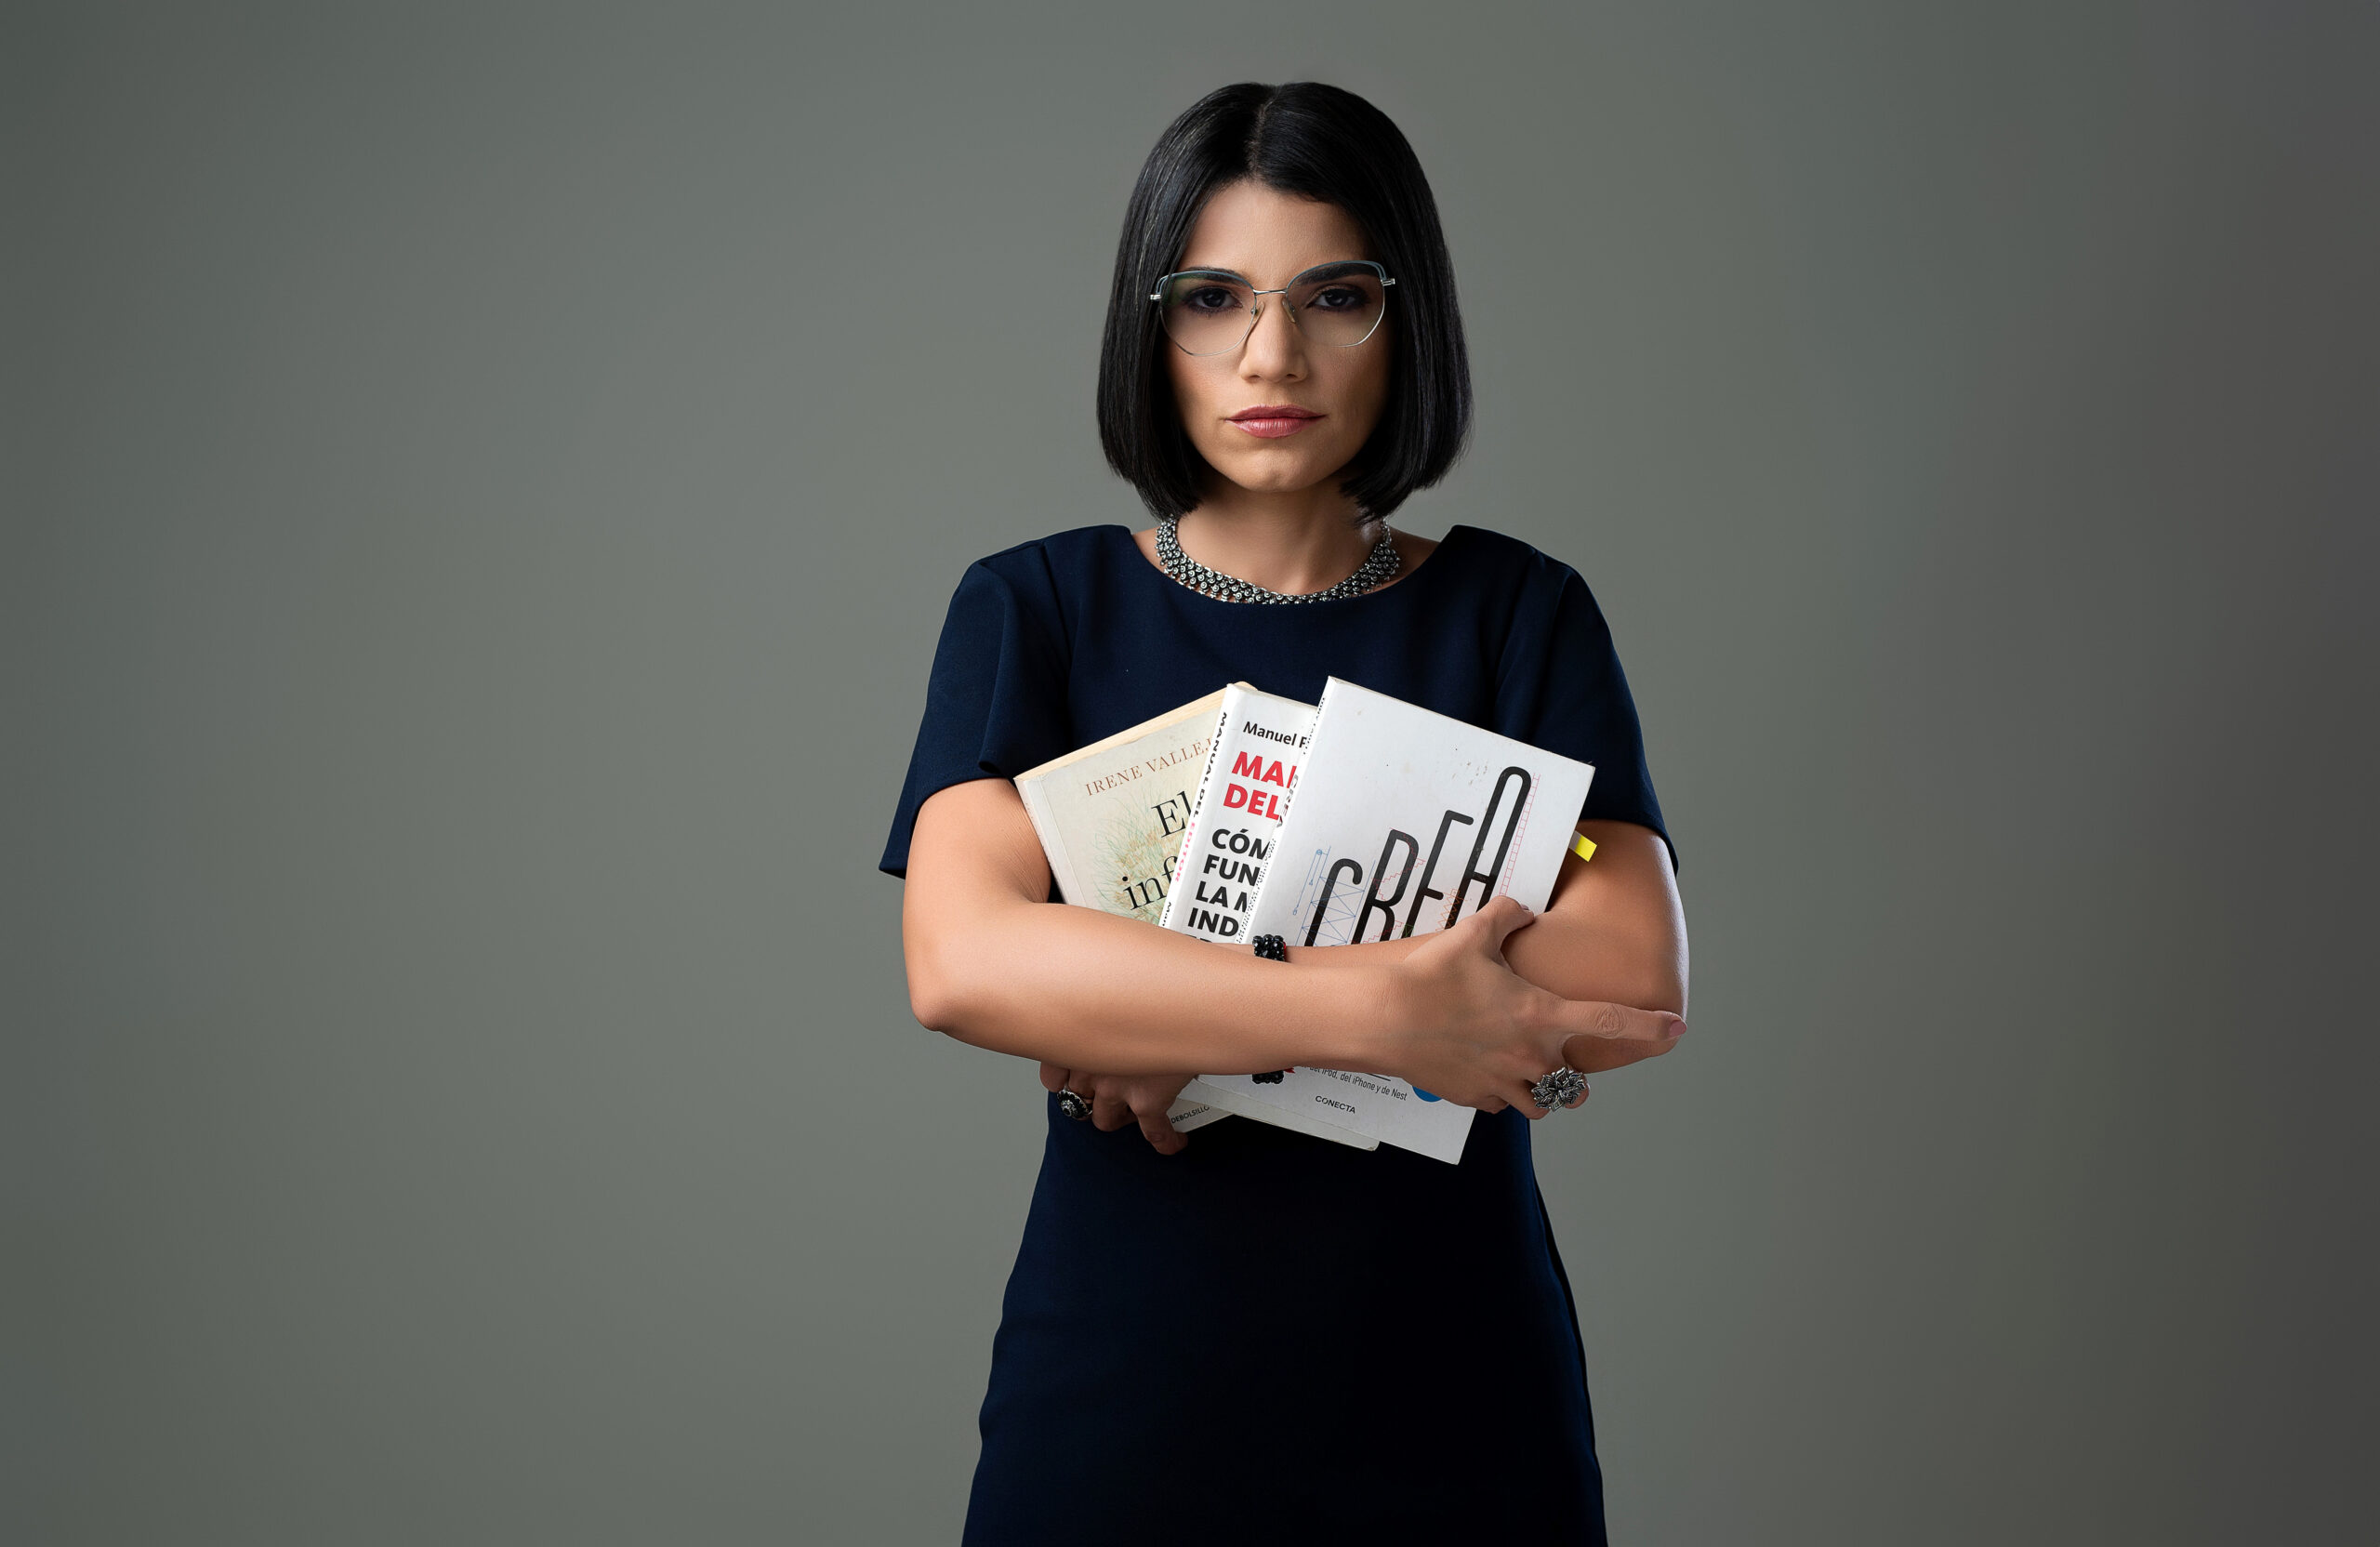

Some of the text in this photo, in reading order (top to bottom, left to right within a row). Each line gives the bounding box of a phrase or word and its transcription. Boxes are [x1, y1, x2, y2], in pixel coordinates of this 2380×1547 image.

[1203, 712, 1227, 785] MANUAL
[1243, 721, 1298, 747] Manuel
[1086, 766, 1143, 796] IRENE
[1151, 790, 1192, 838] El
[1194, 788, 1205, 817] DEL
[1223, 783, 1280, 821] DEL
[1175, 822, 1196, 882] EDITOR
[1303, 766, 1532, 947] CREA
[1122, 855, 1179, 910] inf
[1203, 853, 1261, 887] FUN
[1195, 880, 1229, 908] LA
[1187, 906, 1239, 937] IND
[1340, 1072, 1352, 1083] del
[1352, 1075, 1376, 1091] iPhone
[1375, 1085, 1382, 1094] y
[1381, 1085, 1391, 1095] de
[1391, 1088, 1408, 1101] Nest
[1315, 1095, 1356, 1114] CONECTA
